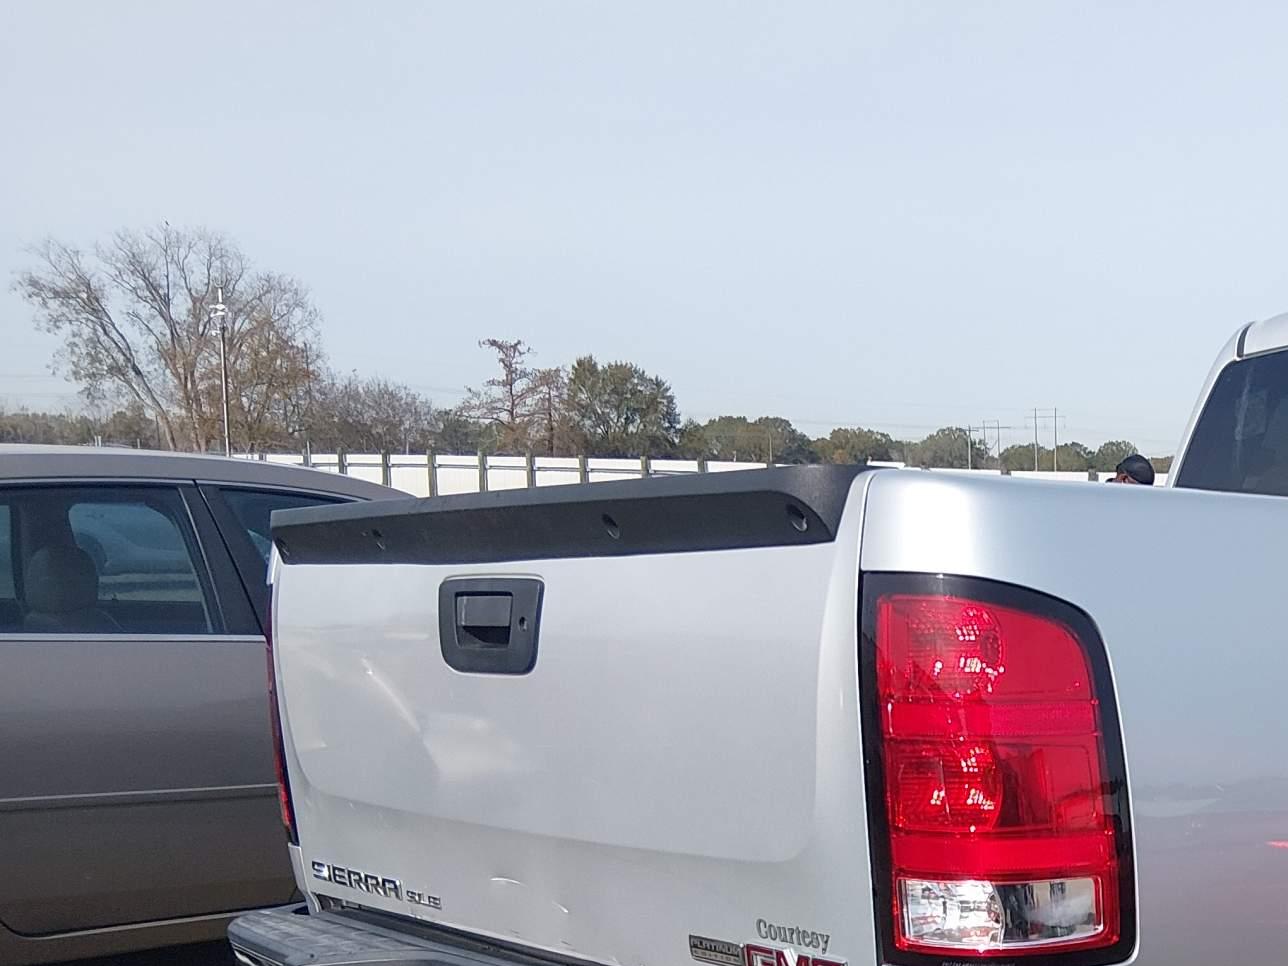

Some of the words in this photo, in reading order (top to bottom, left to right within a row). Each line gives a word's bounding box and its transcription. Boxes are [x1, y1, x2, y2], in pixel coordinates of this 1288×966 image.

[312, 860, 403, 901] SIERRA
[406, 889, 442, 910] SLE
[691, 938, 741, 956] PLATINUM
[756, 918, 830, 955] Courtesy
